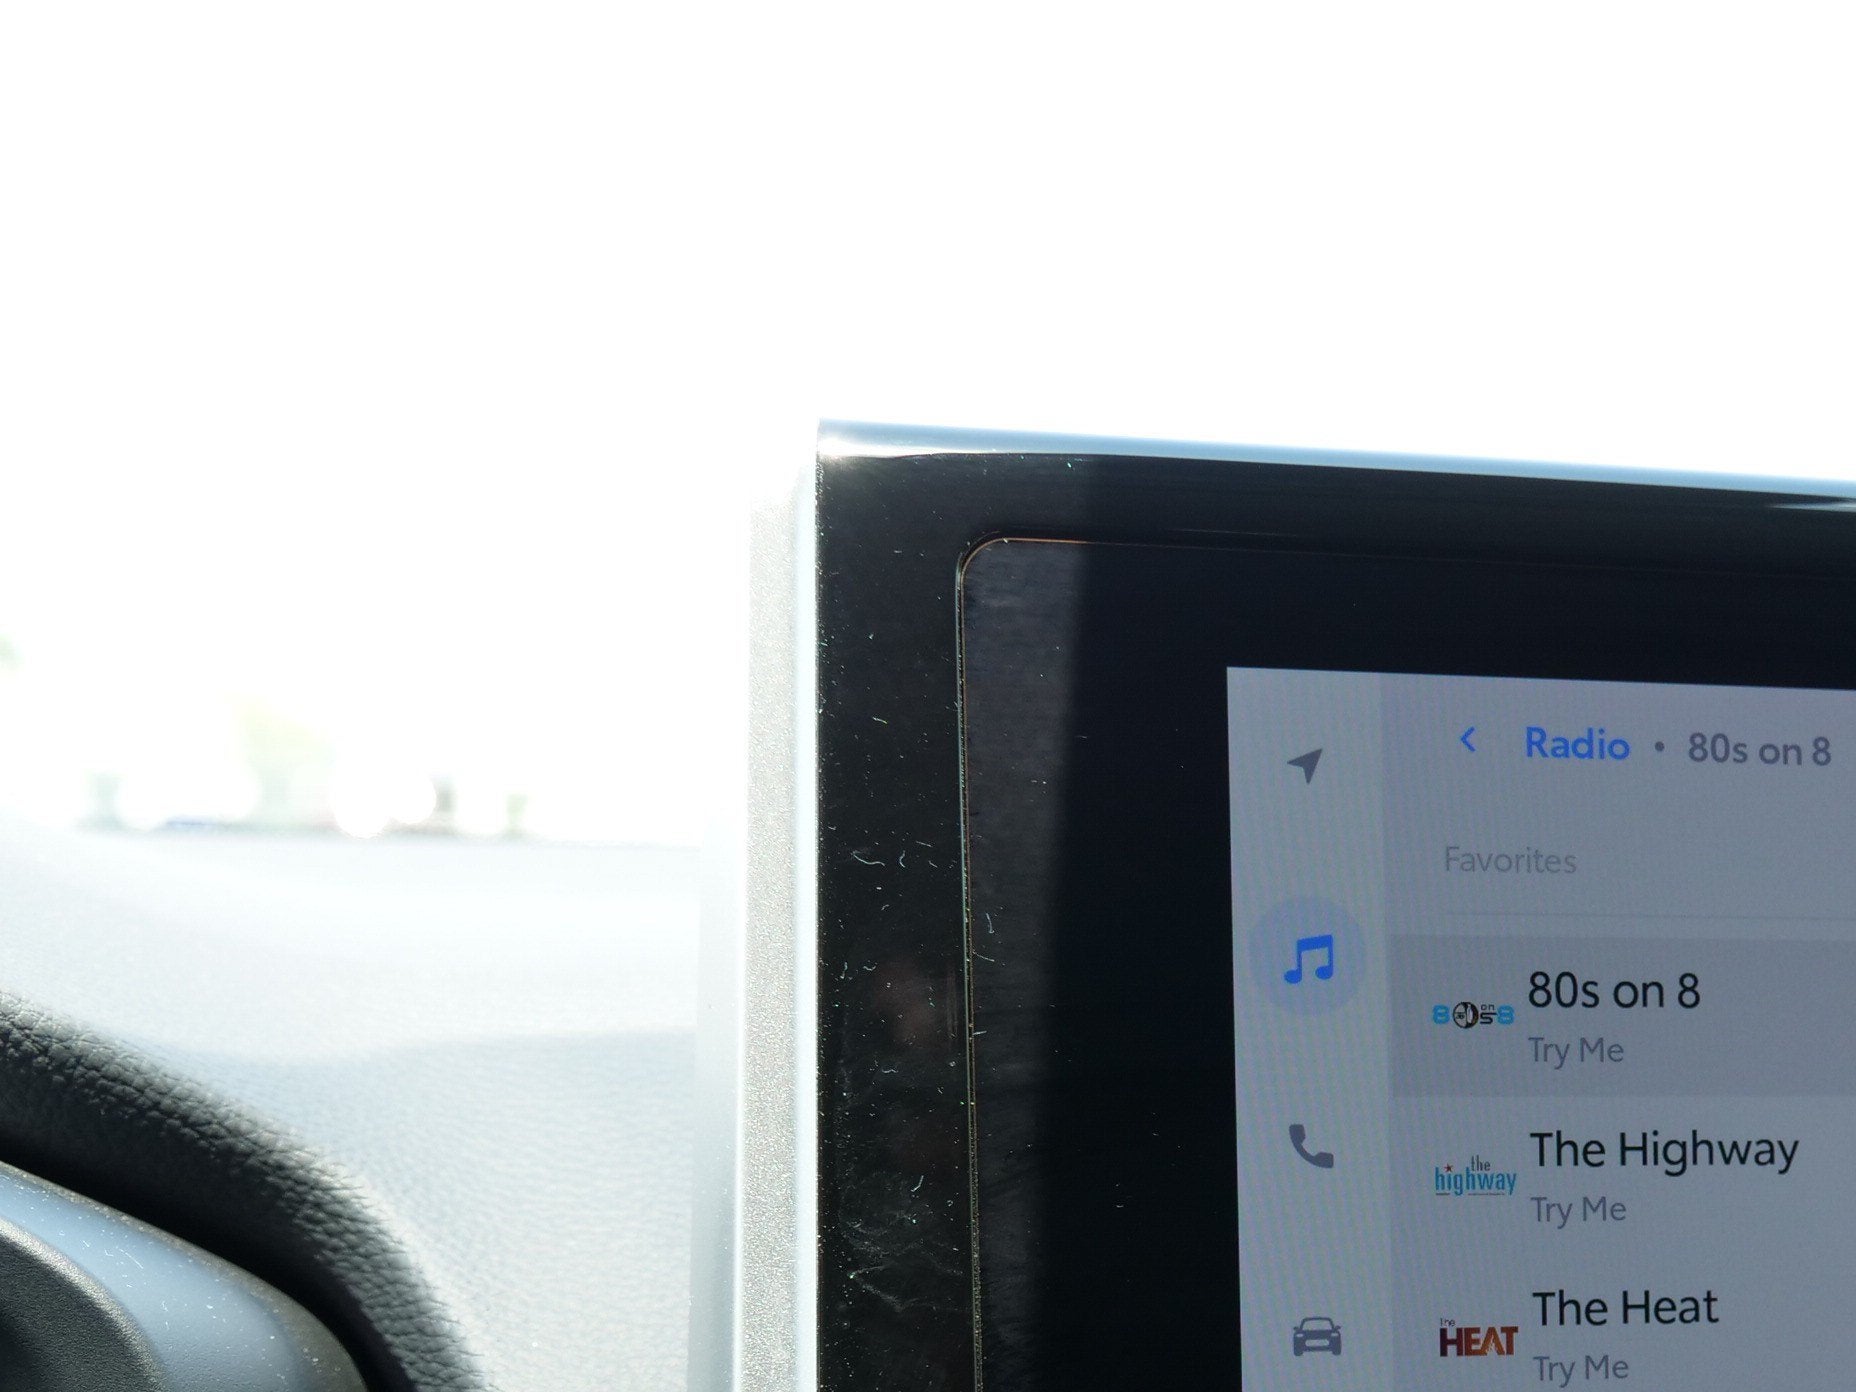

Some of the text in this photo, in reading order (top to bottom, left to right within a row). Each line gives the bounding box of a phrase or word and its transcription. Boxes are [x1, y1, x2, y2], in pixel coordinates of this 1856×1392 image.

[1526, 726, 1832, 766] Radio 80s on 8
[1444, 846, 1578, 876] Favorites
[1529, 971, 1701, 1009] 80s on 8
[1529, 1037, 1625, 1070] Try Me
[1471, 1154, 1491, 1172] the
[1530, 1129, 1799, 1178] The Highway
[1434, 1166, 1517, 1196] highway
[1531, 1195, 1627, 1229] Try Me
[1533, 1288, 1719, 1328] The Heat
[1440, 1326, 1519, 1357] HEAT
[1534, 1354, 1629, 1388] Try Me
